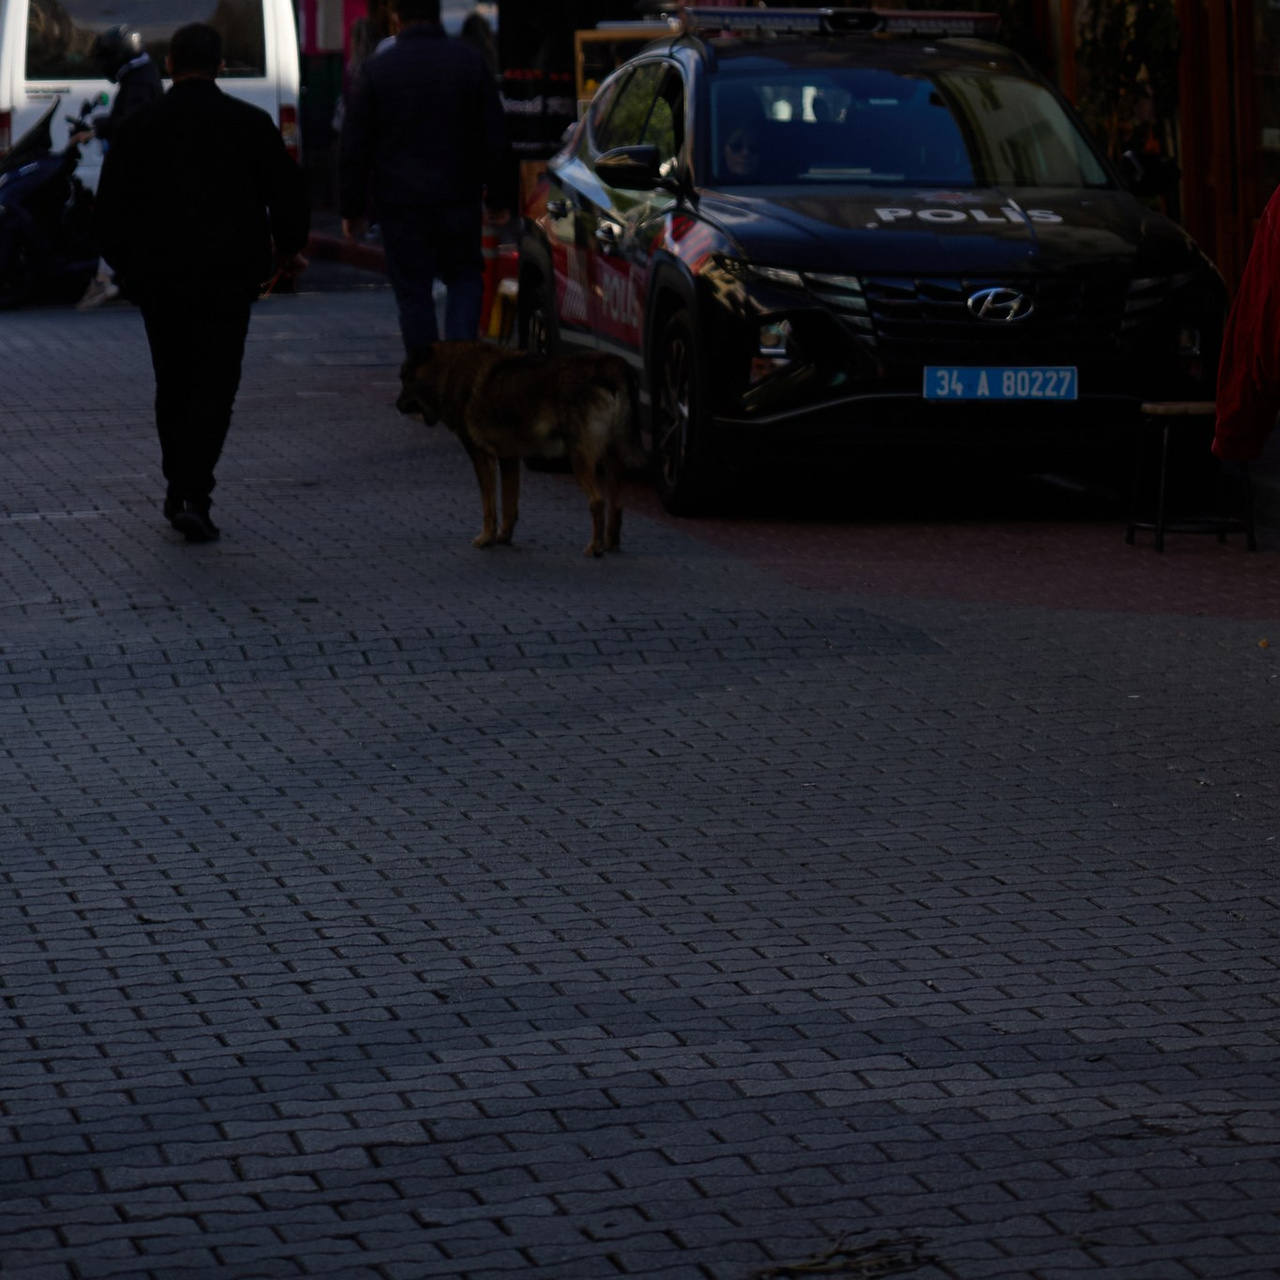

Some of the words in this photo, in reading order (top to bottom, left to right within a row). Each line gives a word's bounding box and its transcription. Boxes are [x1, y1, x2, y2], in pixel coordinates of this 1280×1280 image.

[935, 369, 964, 396] 34
[976, 369, 990, 397] A
[1002, 369, 1073, 397] 80227
